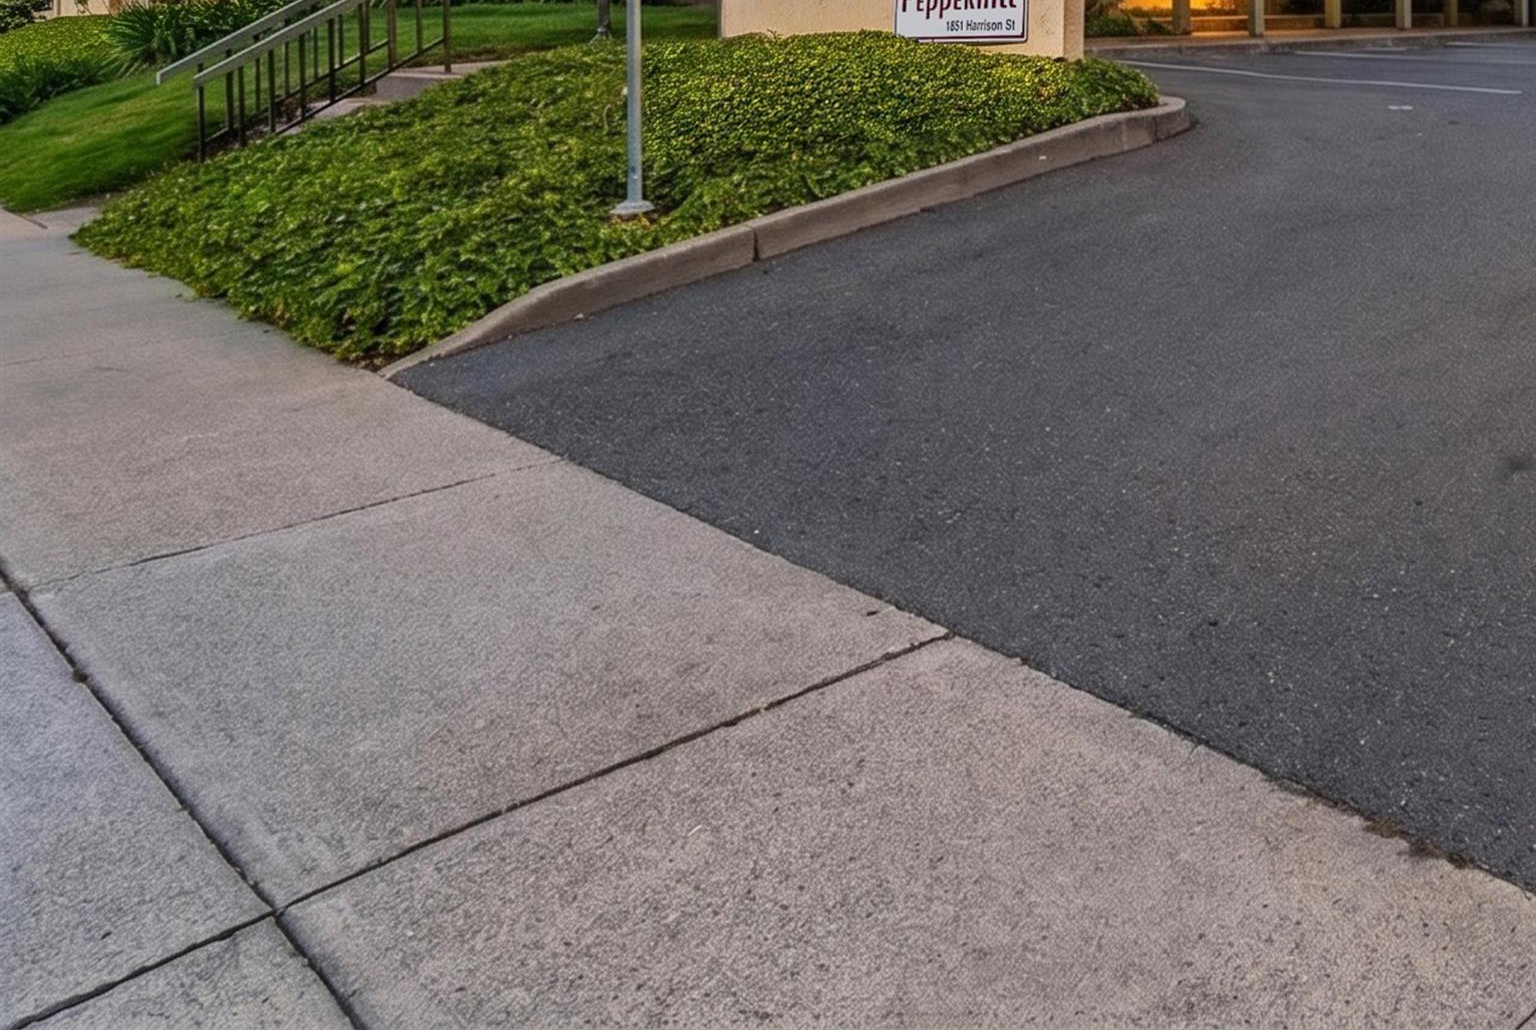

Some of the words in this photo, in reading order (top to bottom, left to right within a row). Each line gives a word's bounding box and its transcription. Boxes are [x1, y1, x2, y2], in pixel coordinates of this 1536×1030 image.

[946, 21, 964, 32] 1851
[966, 19, 1003, 32] Harrison
[1005, 18, 1016, 31] St
